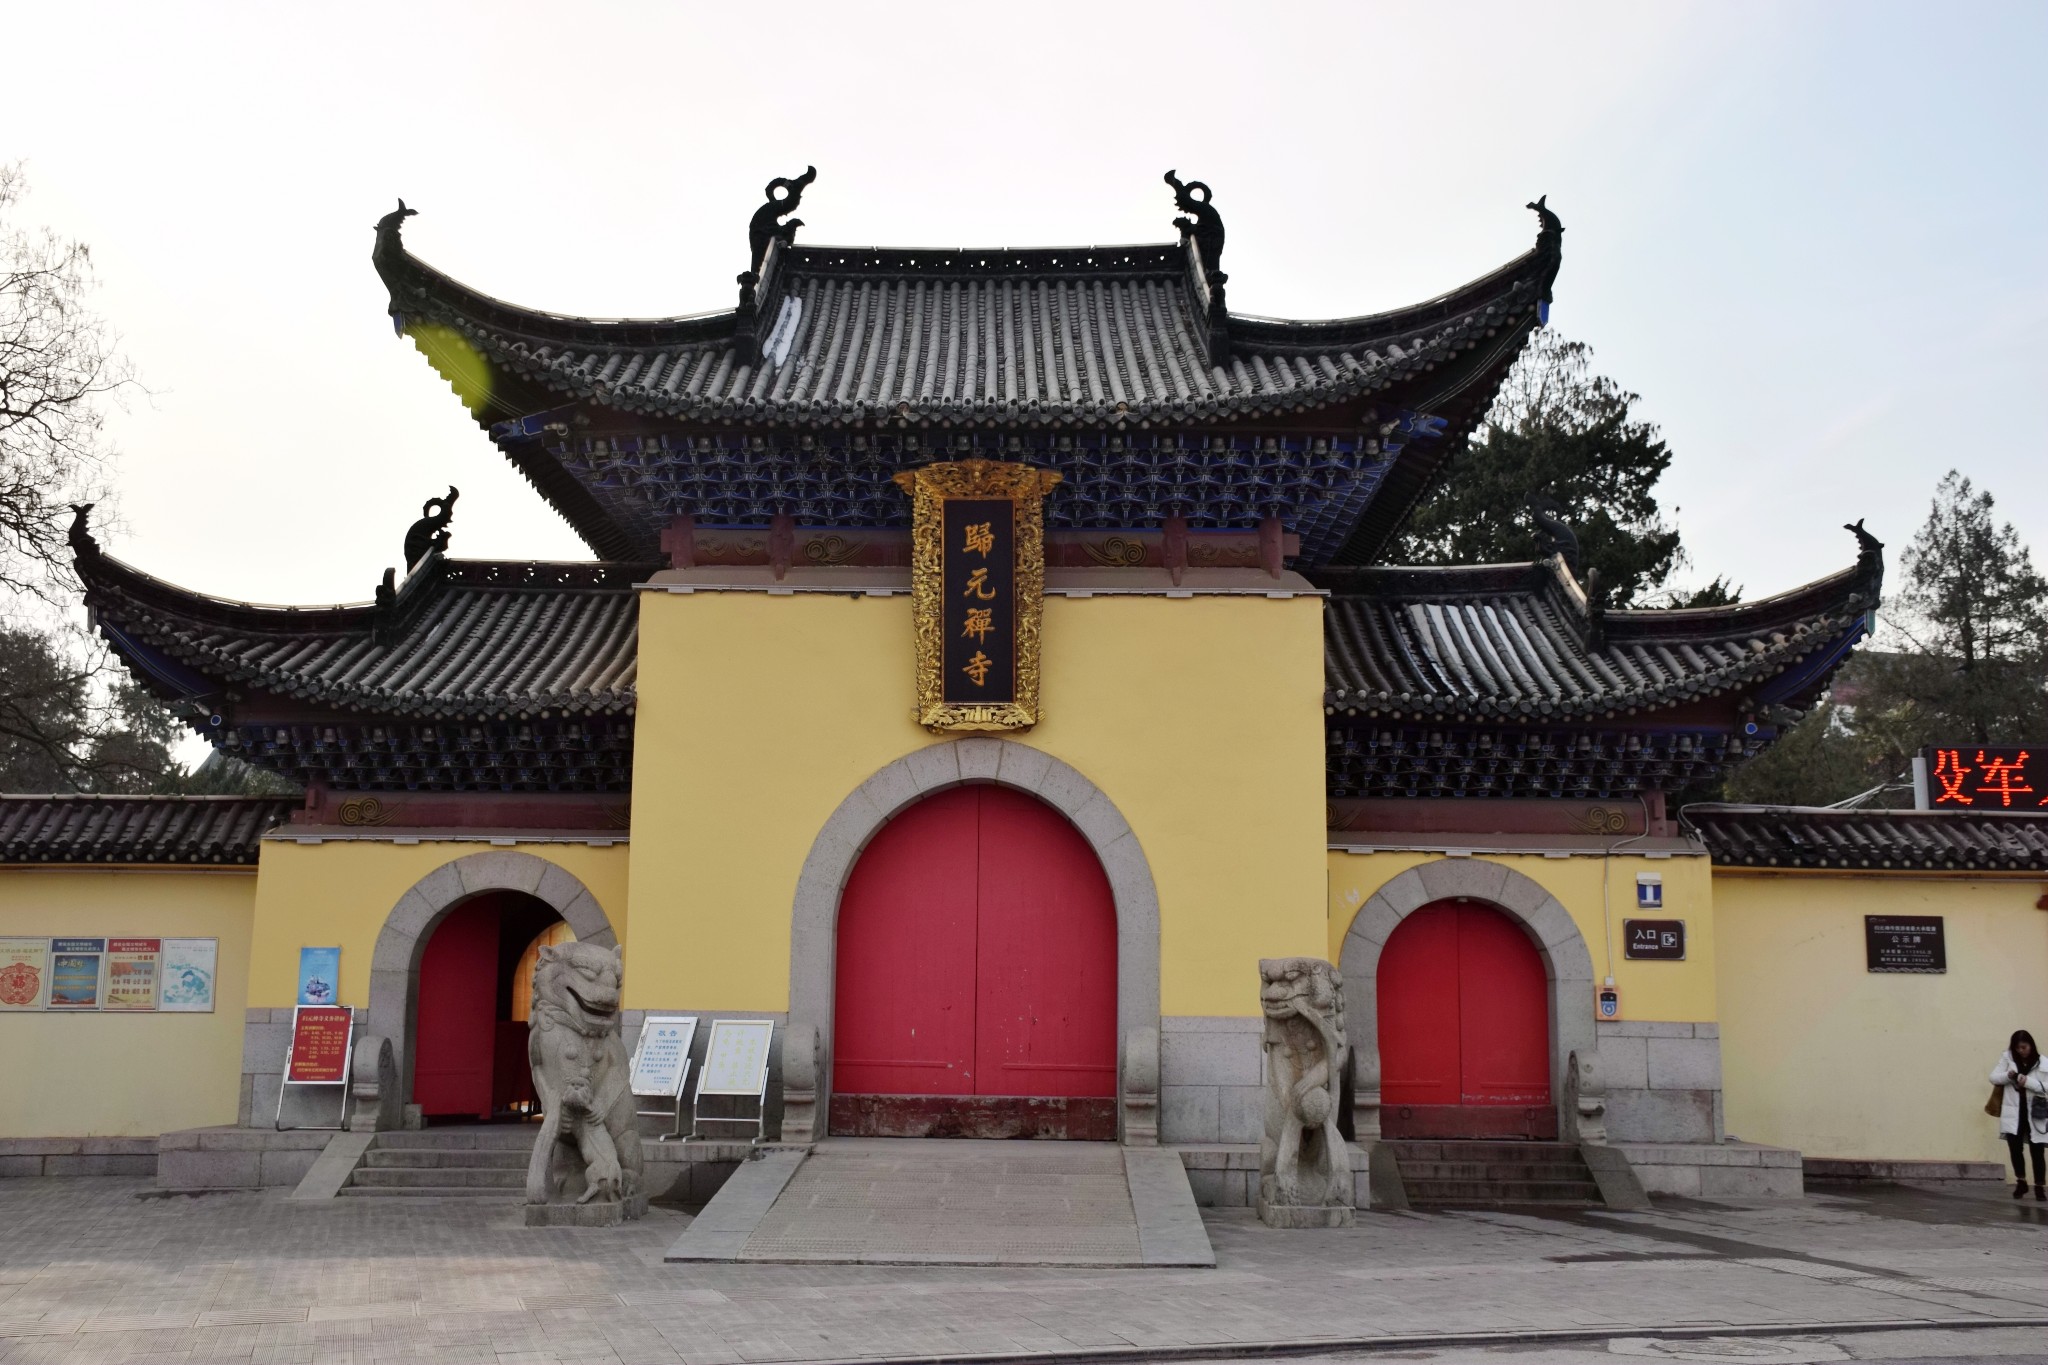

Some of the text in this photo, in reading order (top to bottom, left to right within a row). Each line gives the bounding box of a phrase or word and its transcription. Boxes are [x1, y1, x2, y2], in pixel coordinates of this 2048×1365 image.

[961, 522, 996, 686] 歸元禪寺
[1635, 929, 1656, 940] 入口
